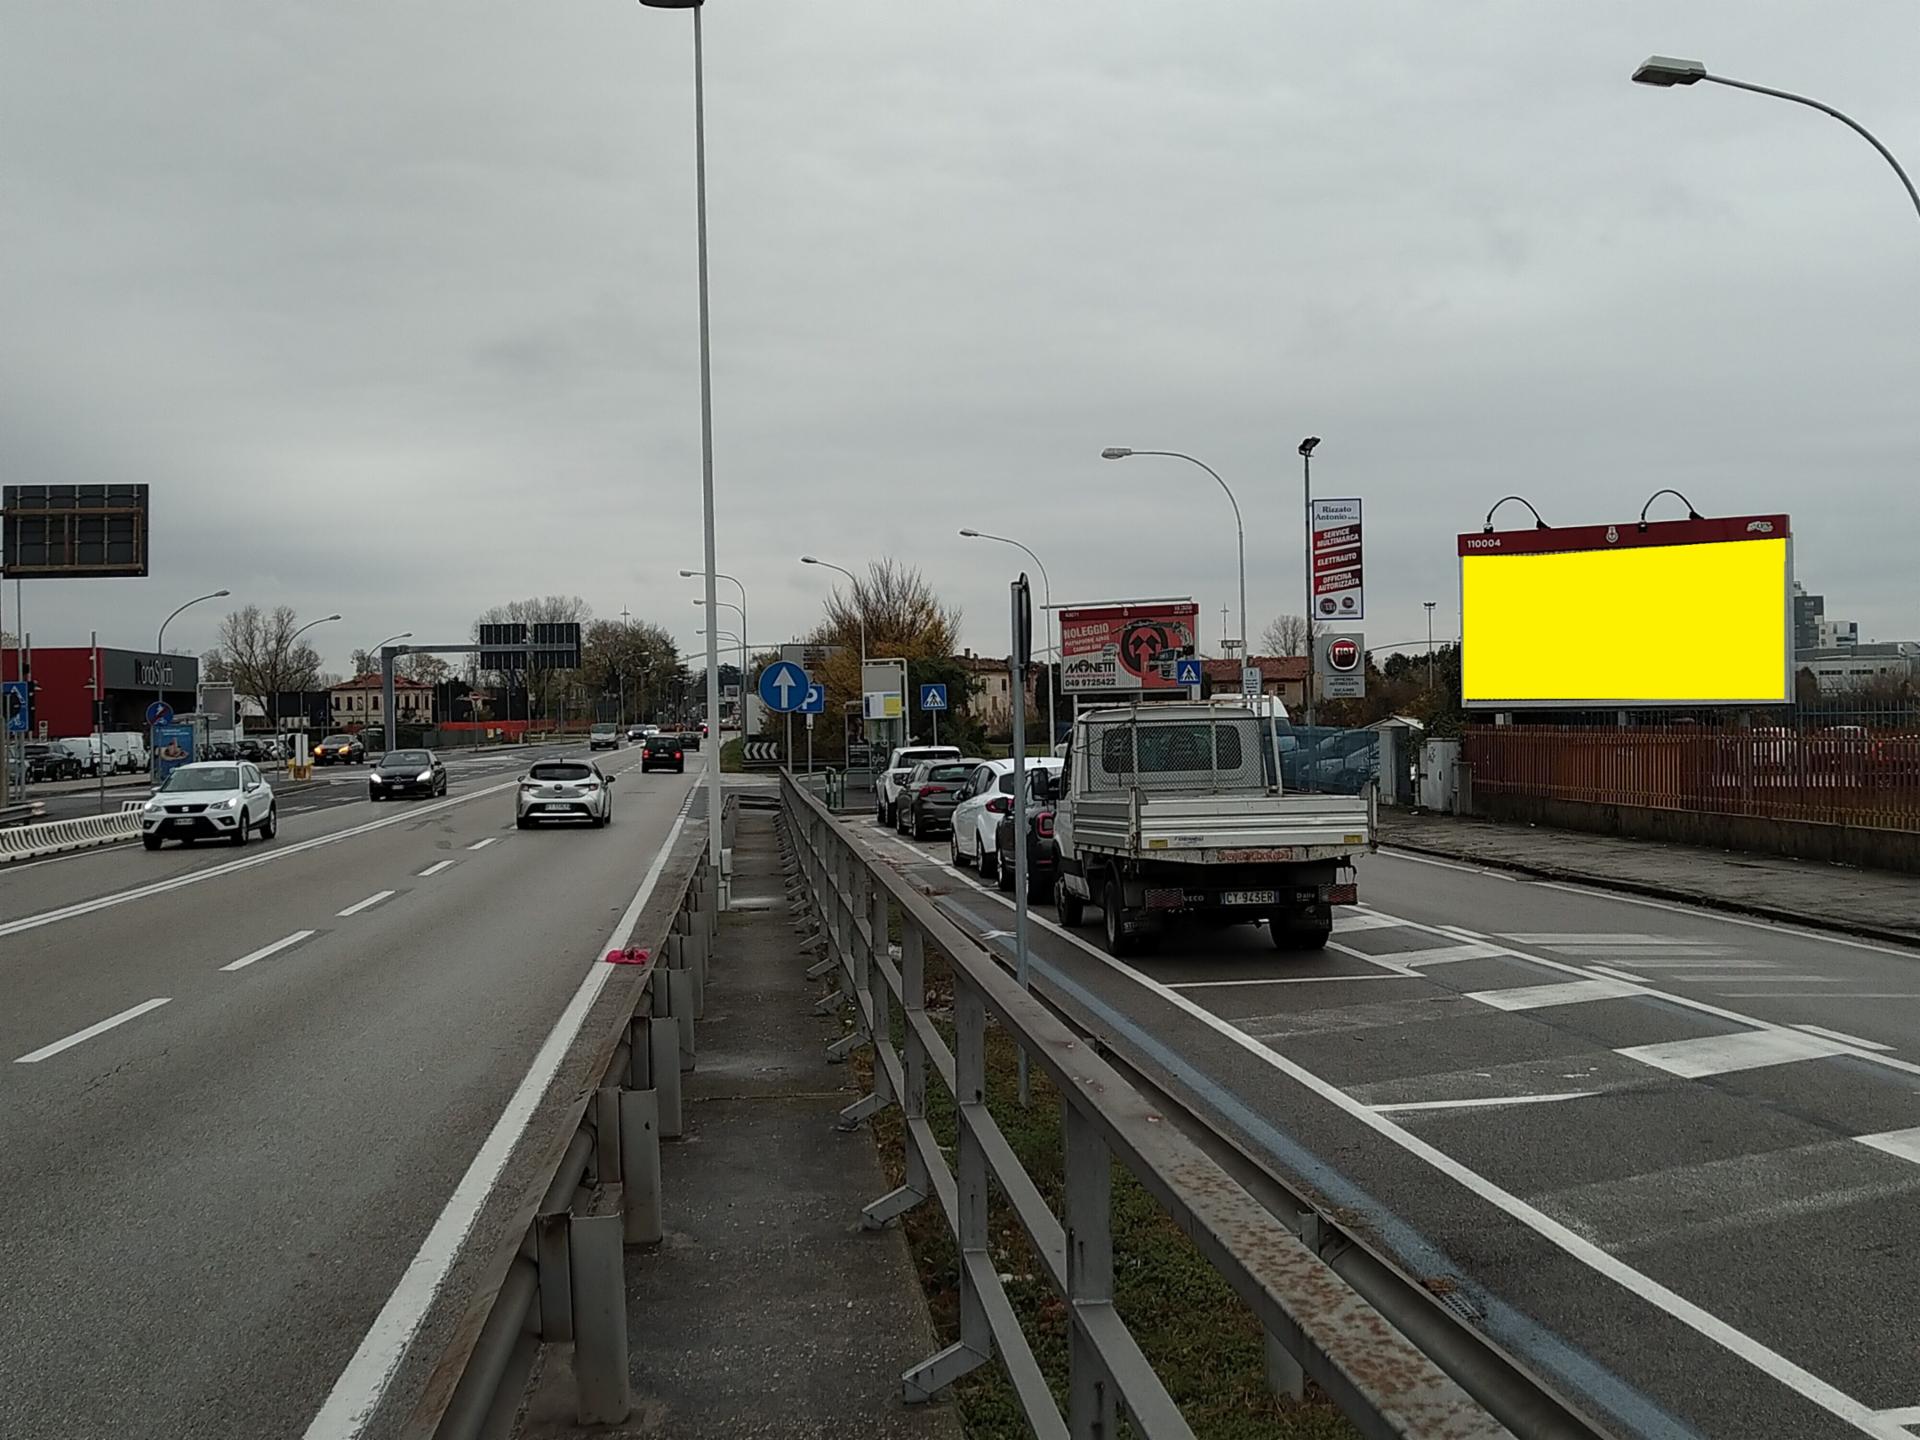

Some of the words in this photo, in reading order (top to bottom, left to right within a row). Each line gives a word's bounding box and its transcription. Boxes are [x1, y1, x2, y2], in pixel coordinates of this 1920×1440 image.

[1315, 513, 1347, 521] Antonio
[1322, 528, 1351, 539] SERVICE
[1317, 533, 1360, 547] MULTIMARCA
[1467, 539, 1501, 548] 110004
[1317, 552, 1357, 566] ELETTRAUTO
[1322, 572, 1352, 583] OFFICINA
[1317, 578, 1360, 592] AUTORIZZATA
[1063, 622, 1109, 640] NOLEGGIO
[1065, 660, 1116, 673] MONETTI
[1065, 679, 1080, 687] 049
[1082, 678, 1116, 687] 9725422
